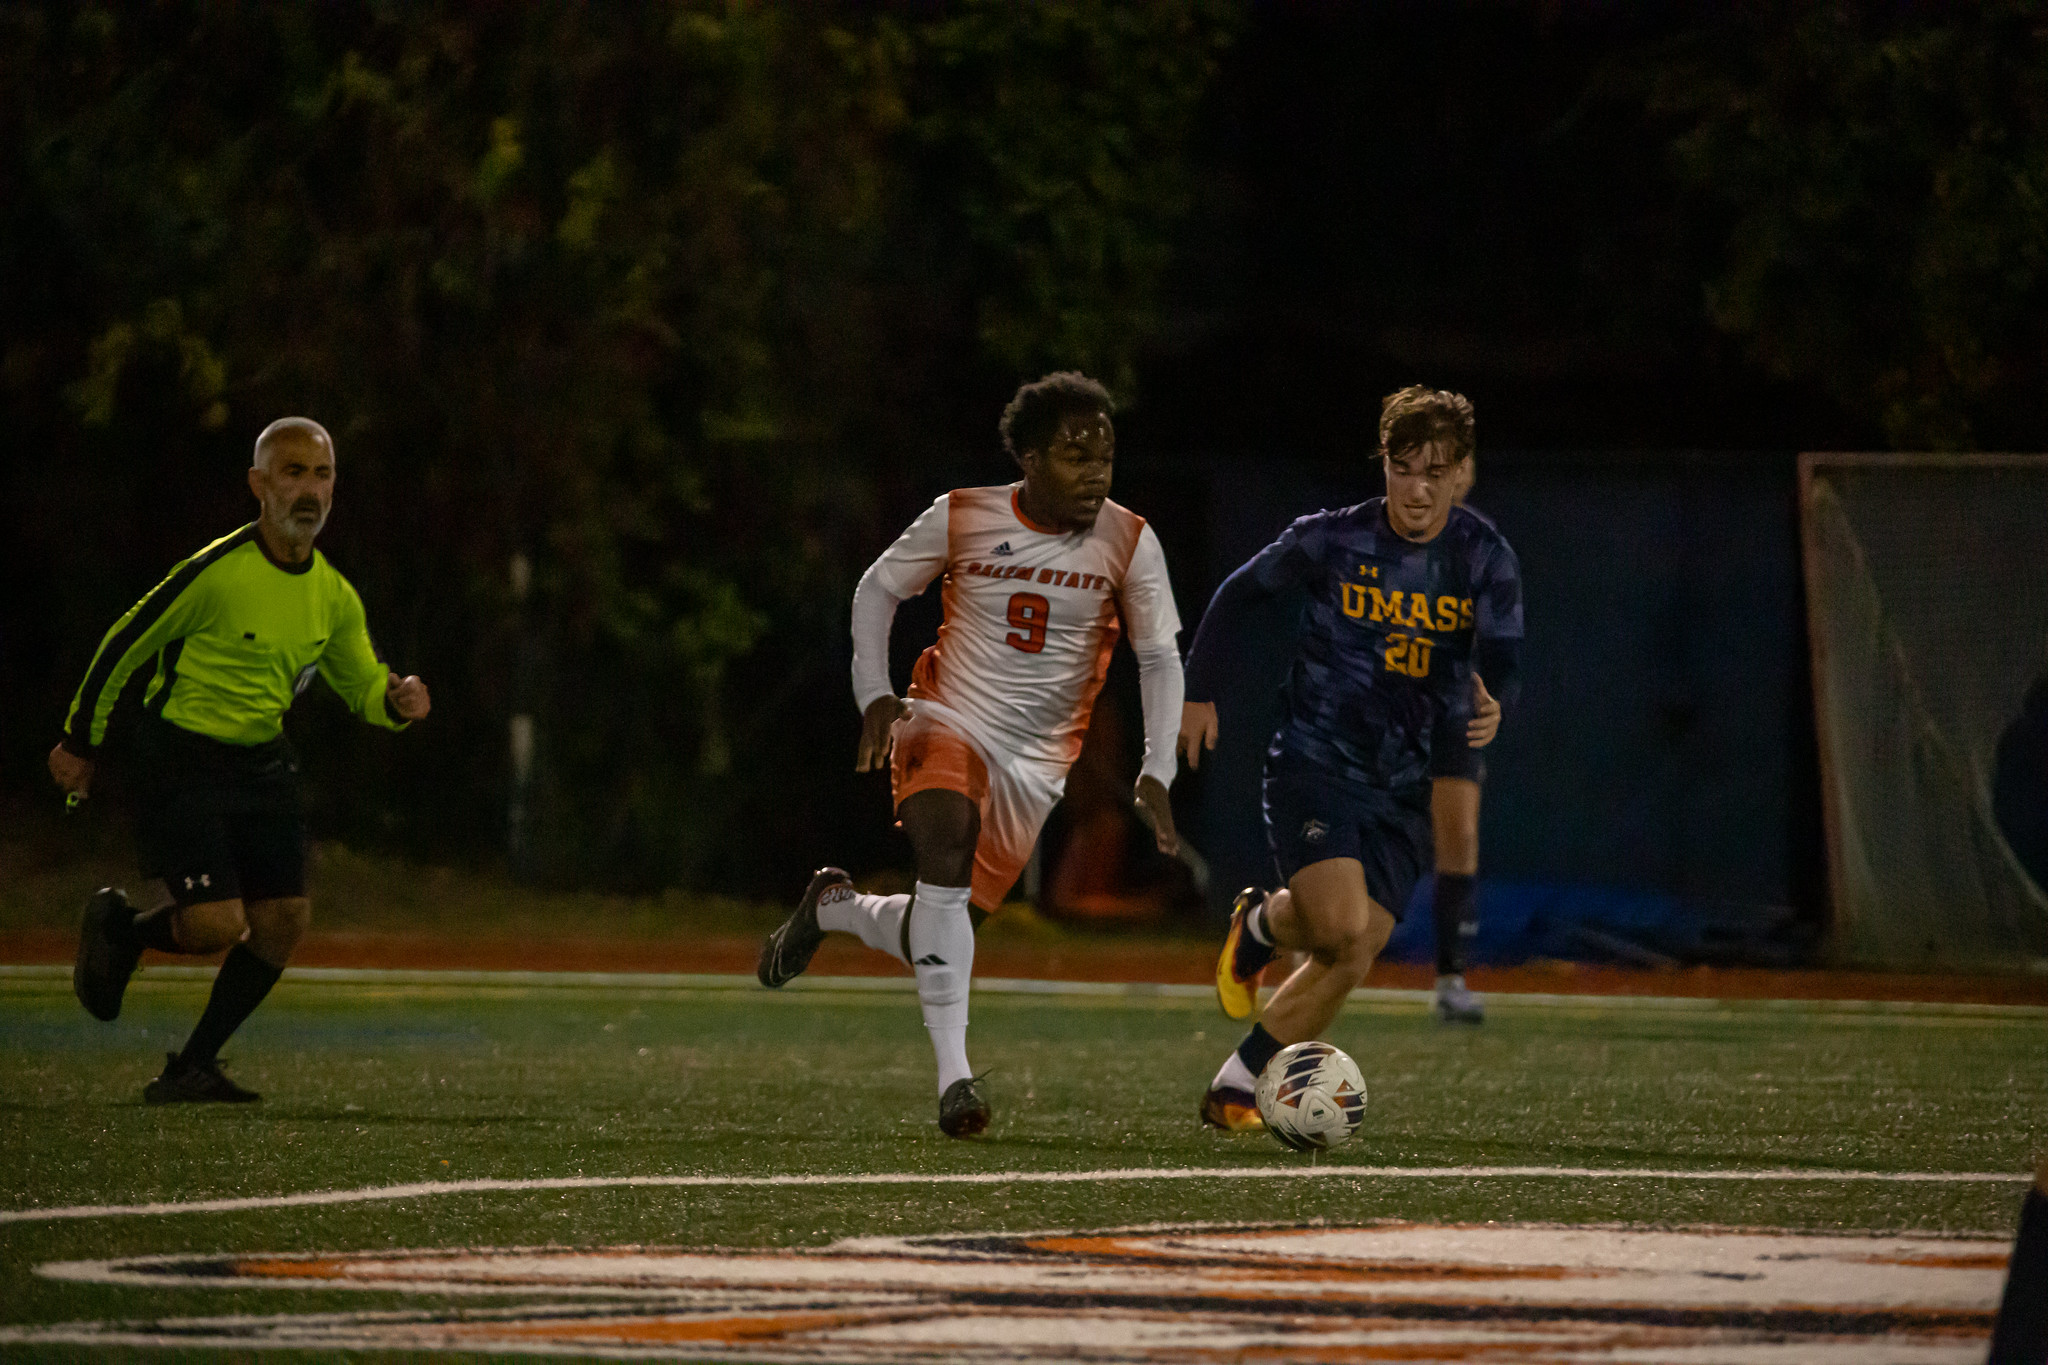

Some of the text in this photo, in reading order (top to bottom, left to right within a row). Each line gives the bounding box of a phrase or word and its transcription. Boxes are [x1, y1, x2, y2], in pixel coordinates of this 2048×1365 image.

[1037, 568, 1106, 590] STATE
[1006, 592, 1050, 654] 9
[1341, 582, 1474, 632] UMASS
[1384, 632, 1436, 678] 20
